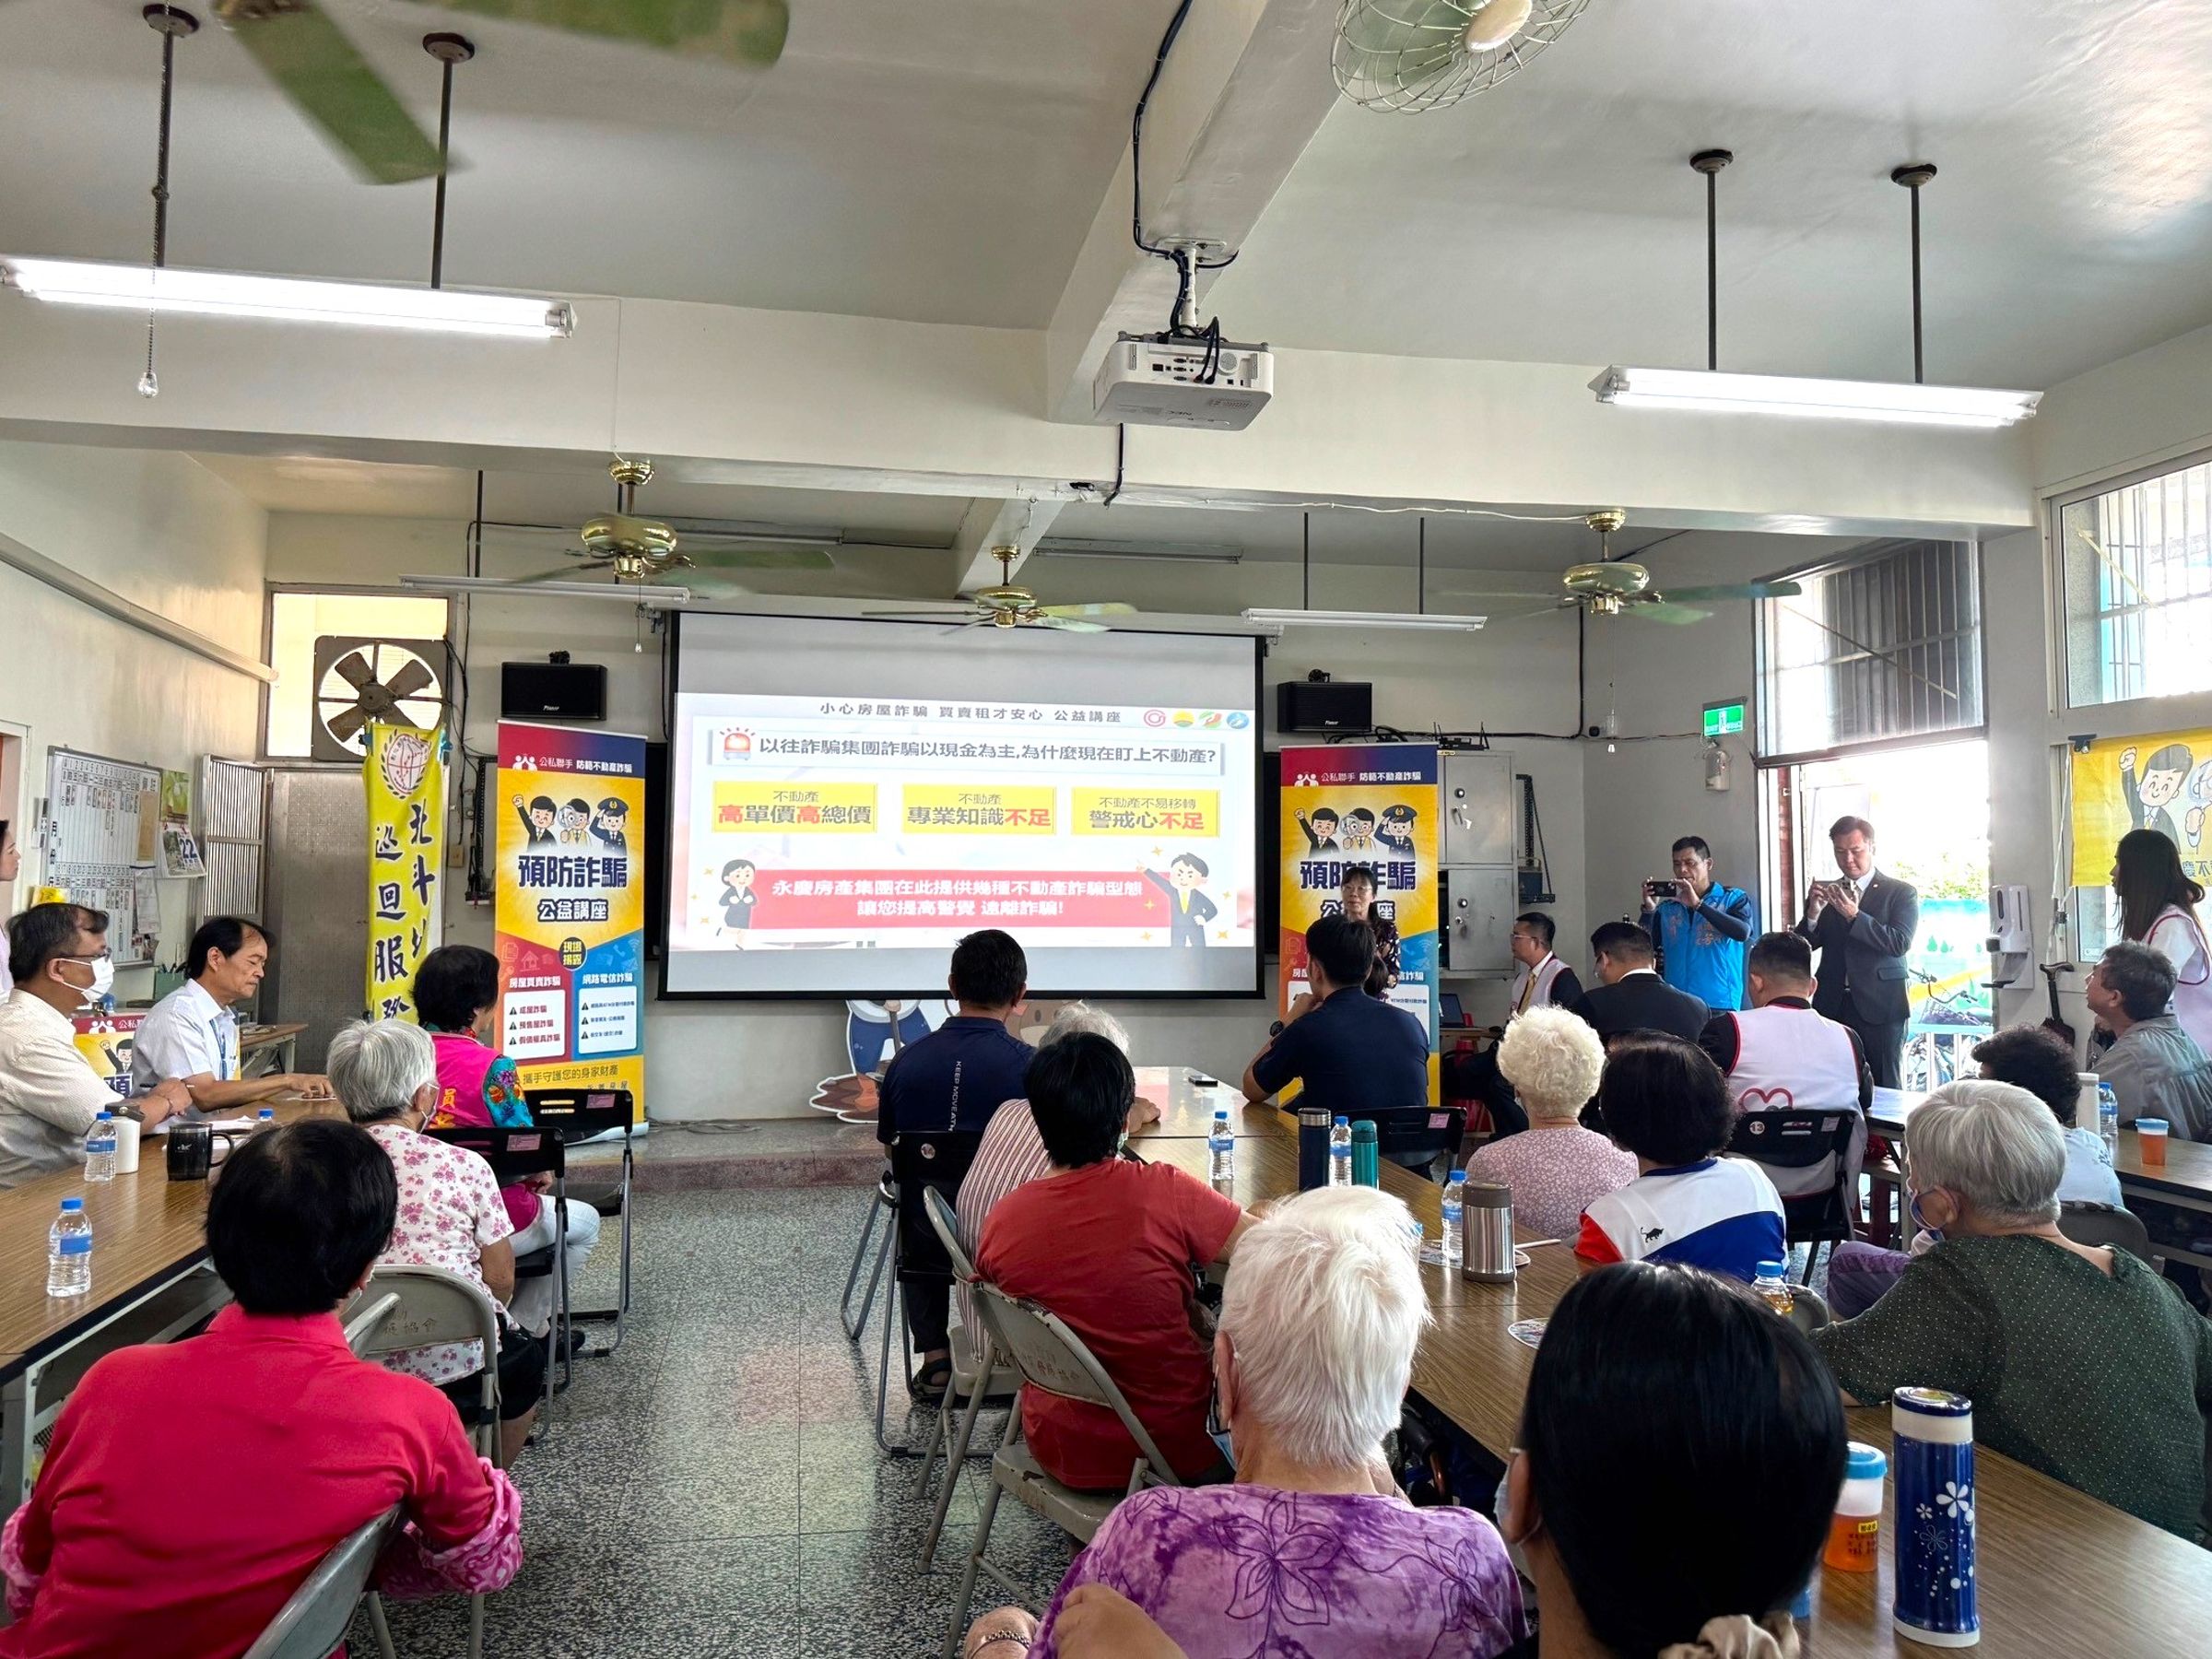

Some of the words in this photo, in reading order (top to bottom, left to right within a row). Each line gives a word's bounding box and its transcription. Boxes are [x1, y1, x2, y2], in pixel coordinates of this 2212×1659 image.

[820, 702, 928, 717] 小心房屋詐騙
[939, 706, 1043, 721] 買賣租才安心
[1053, 709, 1122, 724] 公益講座
[539, 756, 573, 769] 公私聯手
[1321, 772, 1356, 782] 公私聯手
[773, 791, 819, 803] 不動產
[958, 794, 1002, 806] 不動產
[1099, 796, 1196, 809] 不動產不易移轉
[718, 805, 872, 825] 高單價高總價
[907, 806, 1052, 827] 專業知識不足
[1089, 809, 1205, 830] 警戒心不足
[180, 839, 197, 858] 22
[518, 855, 627, 888] 預防詐騙
[538, 900, 607, 922] 公益講座
[857, 900, 976, 916] 讓您提高警覺
[981, 900, 1064, 915] 遠離詐騙!
[954, 1061, 962, 1085] KEEP
[1751, 1122, 1764, 1133] 13
